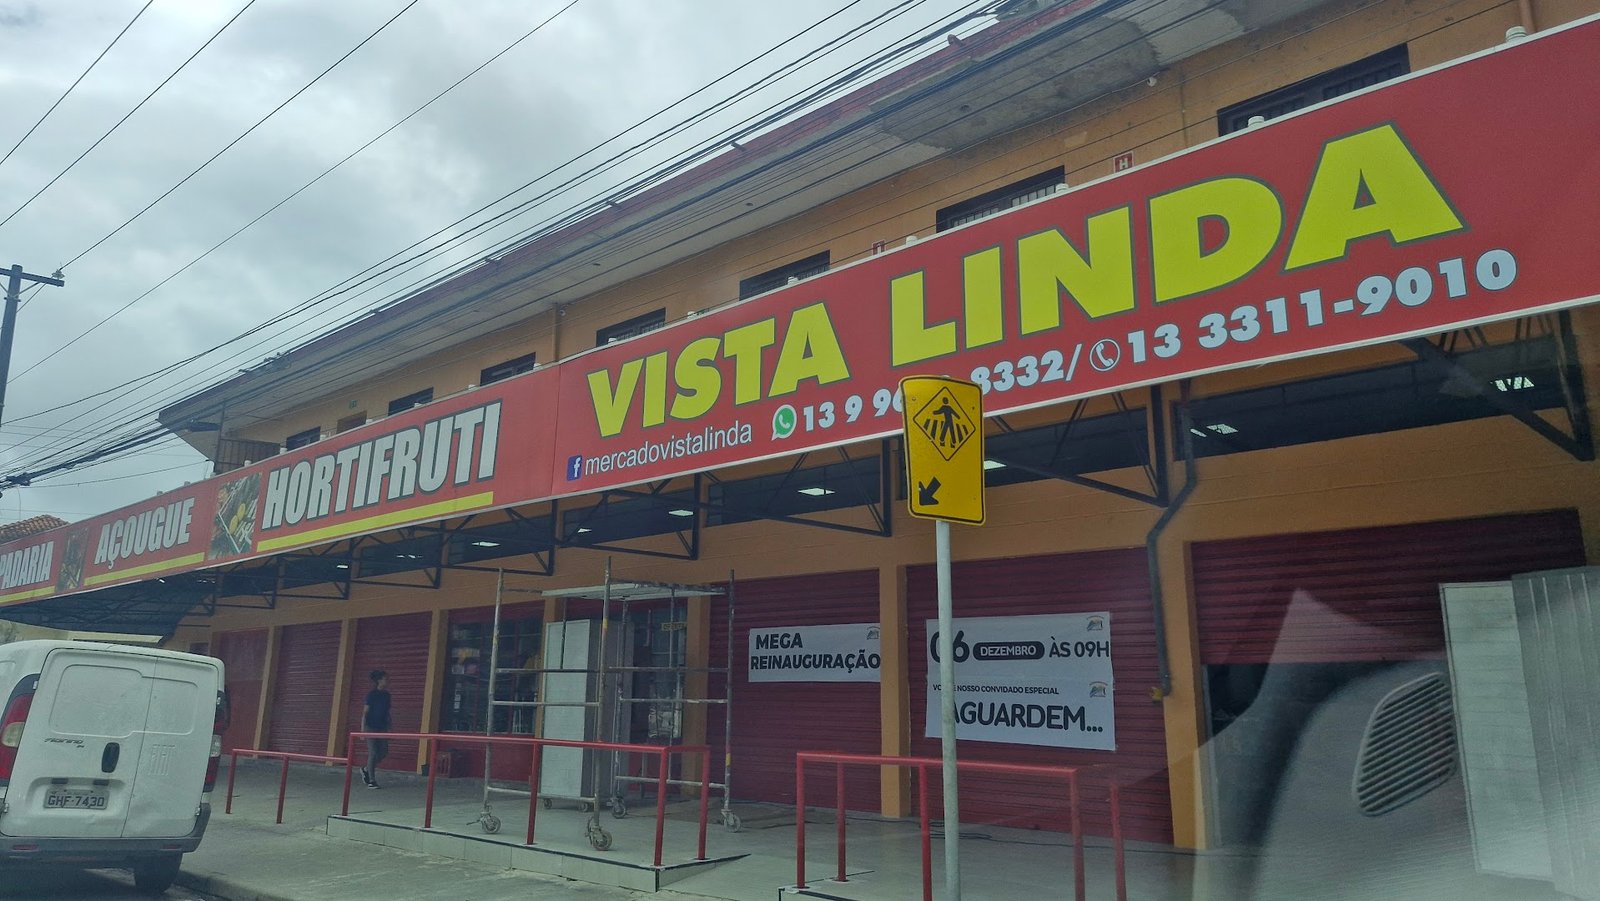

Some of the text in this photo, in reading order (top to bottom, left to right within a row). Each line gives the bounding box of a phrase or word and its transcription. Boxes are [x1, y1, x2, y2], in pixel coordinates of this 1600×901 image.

[586, 122, 1466, 438] VISTA LINDA
[803, 401, 836, 432] 13
[844, 394, 863, 423] 9
[1127, 322, 1182, 364] 13
[1198, 248, 1518, 349] 3311-9010
[260, 399, 502, 531] HORTIFRUTI
[585, 420, 752, 476] mercadovistalinda
[94, 497, 196, 570] AÇOUGUE
[750, 649, 880, 674] REINAUGURAÇÃO
[755, 632, 803, 650] MEGA
[980, 645, 1037, 658] DEZEMBRO
[1049, 636, 1071, 658] ÀS
[1074, 640, 1110, 659] 09H
[956, 684, 981, 692] NOSSO
[981, 685, 1024, 694] CONVIDADO
[1024, 686, 1060, 695] ESPECIAL
